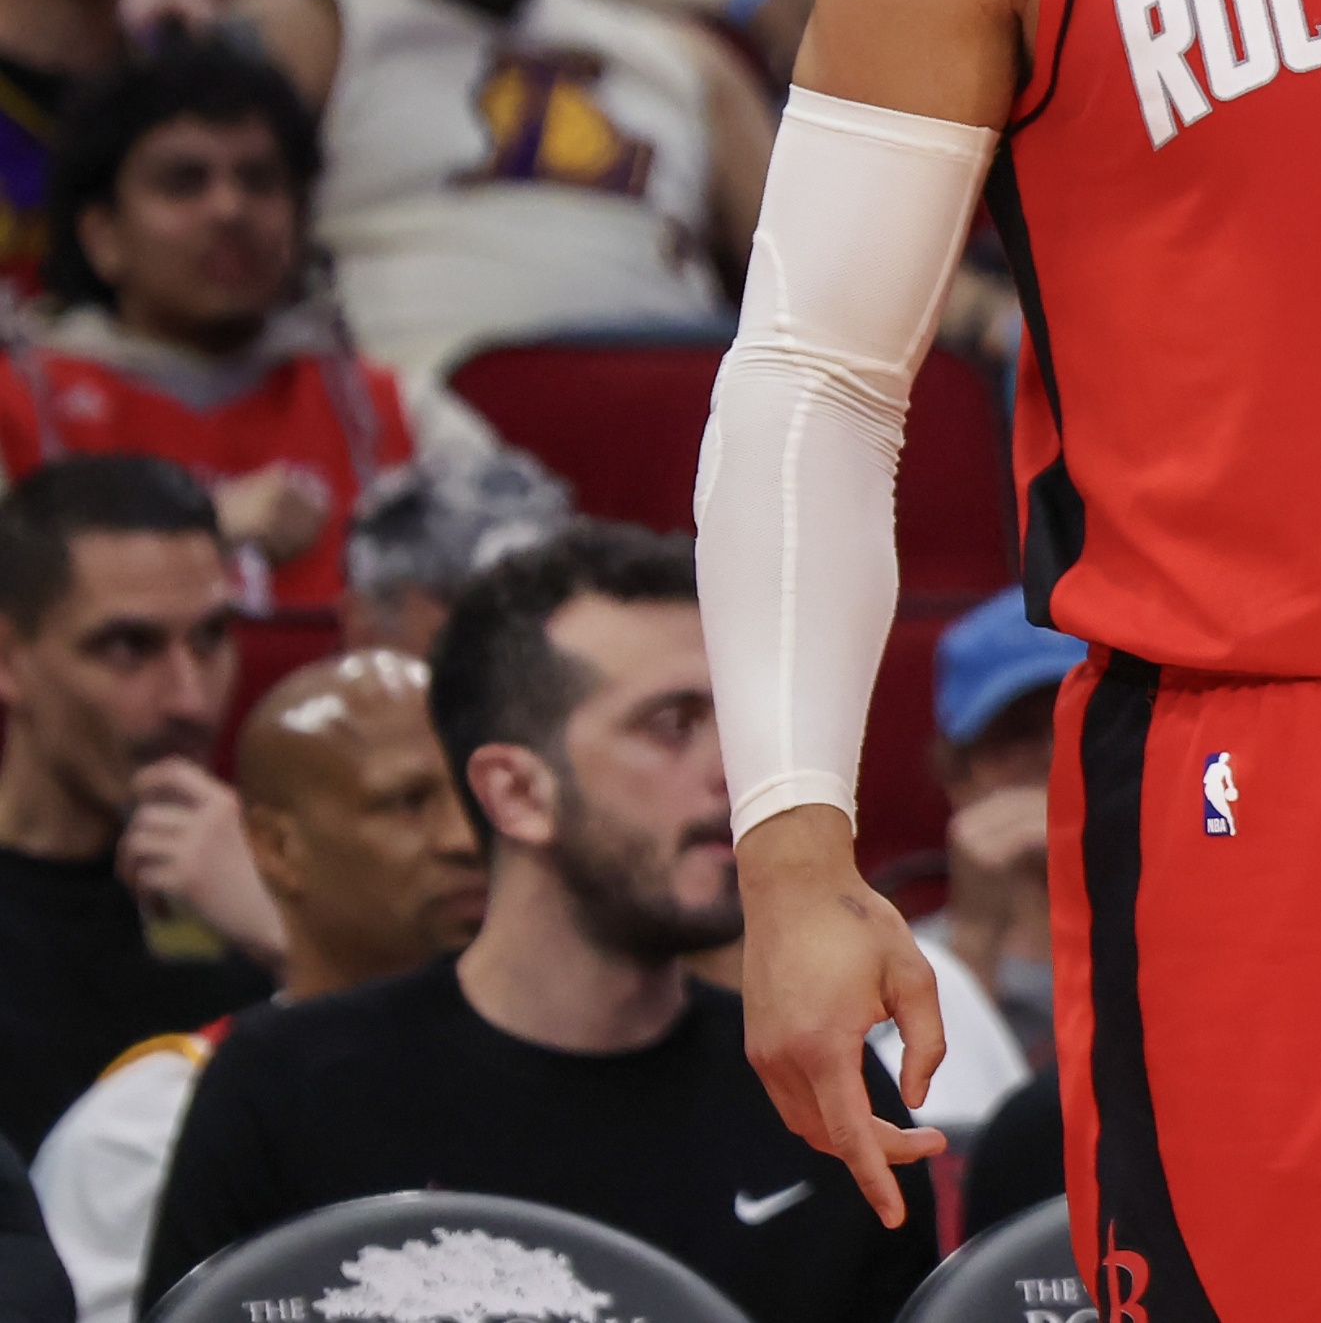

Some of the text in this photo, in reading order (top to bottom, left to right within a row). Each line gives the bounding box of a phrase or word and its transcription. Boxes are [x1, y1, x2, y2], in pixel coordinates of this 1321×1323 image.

[1206, 817, 1227, 833] NBA
[1015, 1278, 1078, 1303] THE
[241, 1297, 305, 1322] THE
